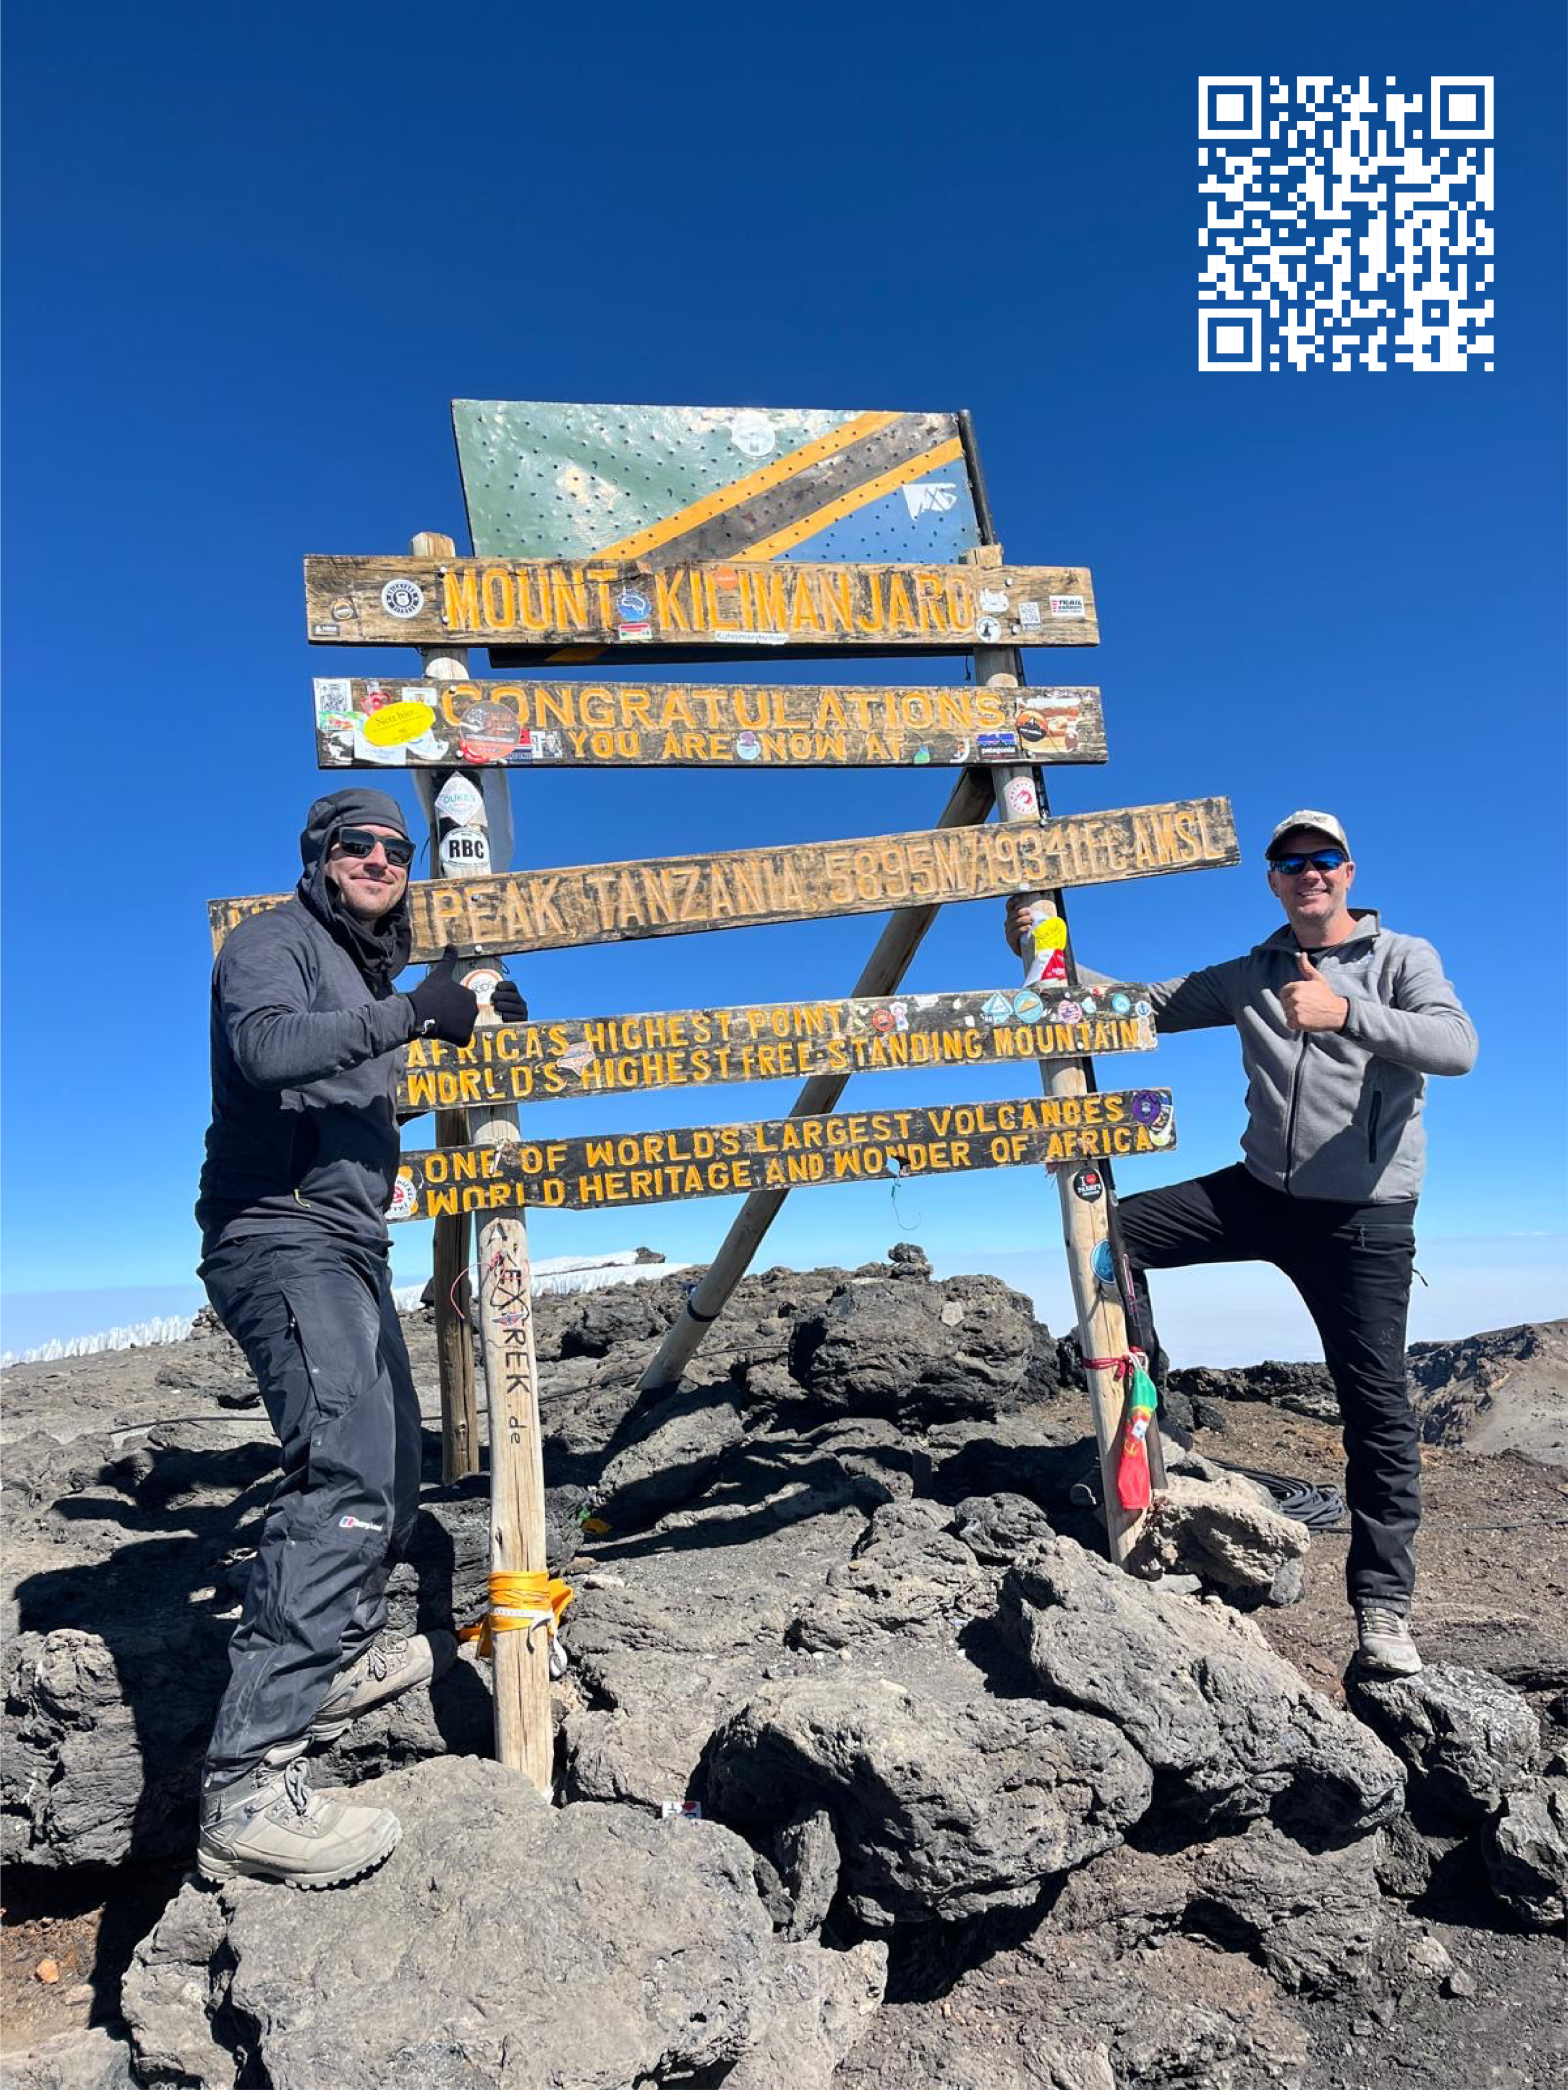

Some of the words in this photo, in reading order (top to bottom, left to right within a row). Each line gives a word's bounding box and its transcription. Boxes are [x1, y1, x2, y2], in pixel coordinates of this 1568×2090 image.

[442, 566, 620, 632] MOUNT
[655, 568, 975, 635] KILIMANJARO
[441, 684, 1007, 731] CONGRATULATIONS
[567, 731, 639, 760] YOU
[662, 731, 732, 762] ARE
[762, 732, 849, 762] NOW
[866, 731, 904, 763] AT
[448, 839, 485, 860] RBC
[1132, 806, 1227, 870] AMSL
[581, 1048, 732, 1089] HIGHEST
[993, 1017, 1139, 1057] MOUNTAIN
[585, 1010, 733, 1053] HIGHEST
[748, 1003, 844, 1040] POINT
[424, 1149, 503, 1184] ONE
[520, 1143, 568, 1175] OF
[756, 1112, 912, 1153] LARGEST
[928, 1095, 1125, 1137] VOLCANOES
[426, 1177, 566, 1218] WORLD
[578, 1159, 753, 1204] HERITAGE
[765, 1152, 824, 1185] AND
[991, 1134, 1030, 1164] OF
[1048, 1125, 1154, 1158] AFRICA
